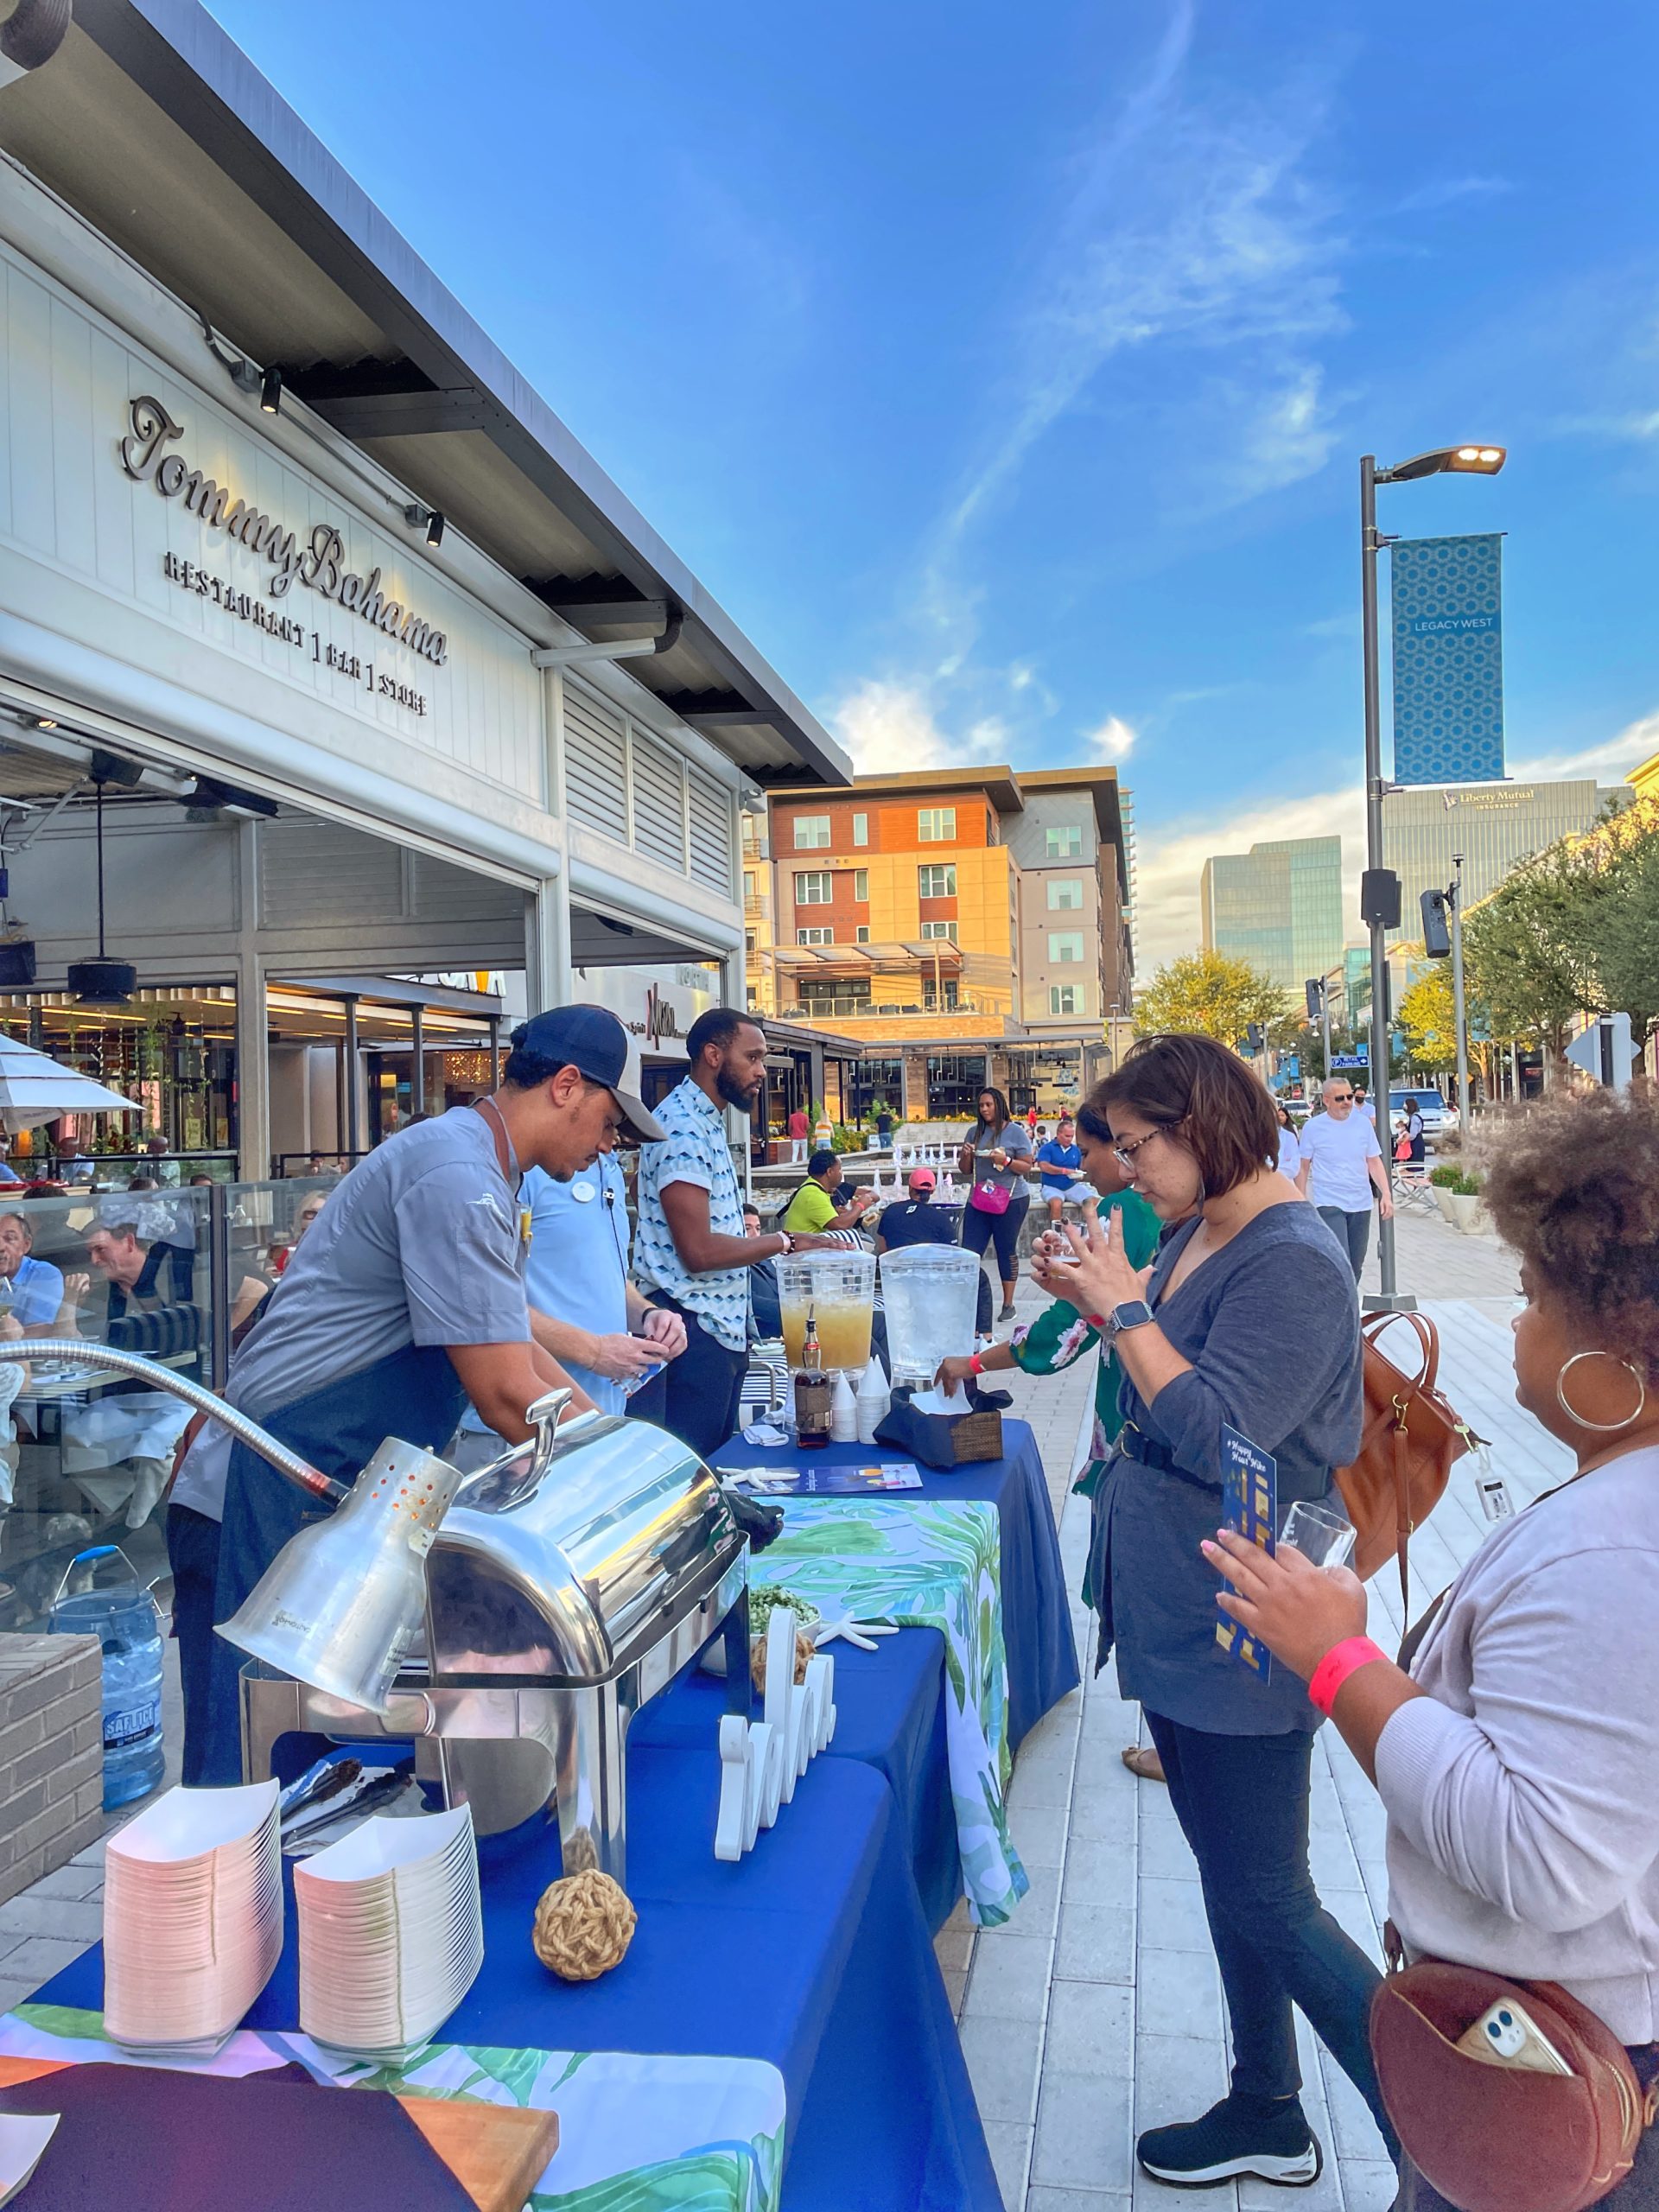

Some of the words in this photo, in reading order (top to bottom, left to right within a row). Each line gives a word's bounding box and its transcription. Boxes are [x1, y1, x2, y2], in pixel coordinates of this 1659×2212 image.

[121, 395, 299, 598] Tommy
[302, 524, 448, 666] Bahama
[164, 550, 305, 648] RESTAURANT
[327, 642, 361, 680] BAR
[378, 673, 427, 716] STORE
[1414, 620, 1460, 632] LEGACY
[1460, 617, 1493, 628] WEST
[1459, 792, 1496, 804] Liberty
[1497, 788, 1535, 800] Mutual
